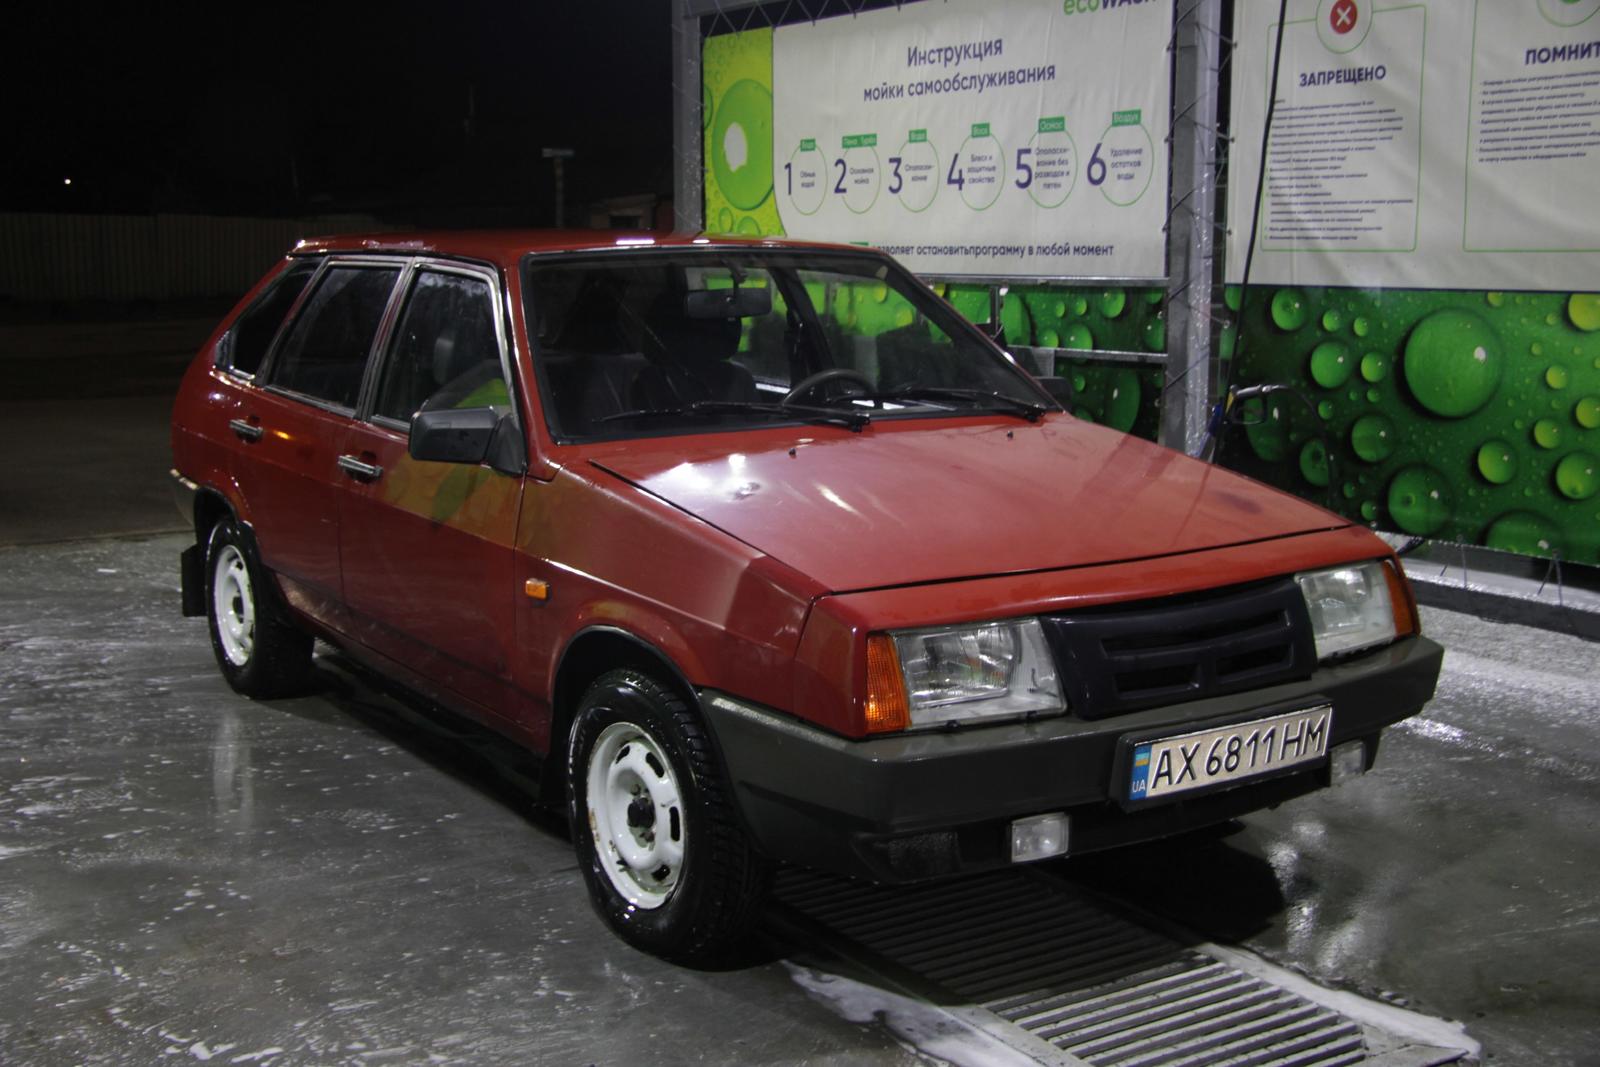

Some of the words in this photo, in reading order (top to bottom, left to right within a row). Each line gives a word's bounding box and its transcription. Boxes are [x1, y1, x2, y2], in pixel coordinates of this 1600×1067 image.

[907, 38, 1003, 68] Инструкция
[864, 81, 904, 101] мойки
[908, 64, 1056, 97] самообслуживания
[1299, 65, 1386, 87] ЗАПРЕЩЕНО
[784, 162, 792, 195] 1
[834, 158, 847, 193] 2
[888, 157, 903, 194] 3
[947, 153, 965, 191] 4
[1015, 148, 1033, 189] 5
[1087, 143, 1107, 186] 6
[1028, 246, 1034, 256] в
[1036, 242, 1070, 256] любой
[1073, 243, 1115, 256] момент
[1152, 741, 1200, 789] AX
[1205, 725, 1277, 776] 6811
[1279, 714, 1325, 761] HM
[1132, 778, 1146, 793] UA
